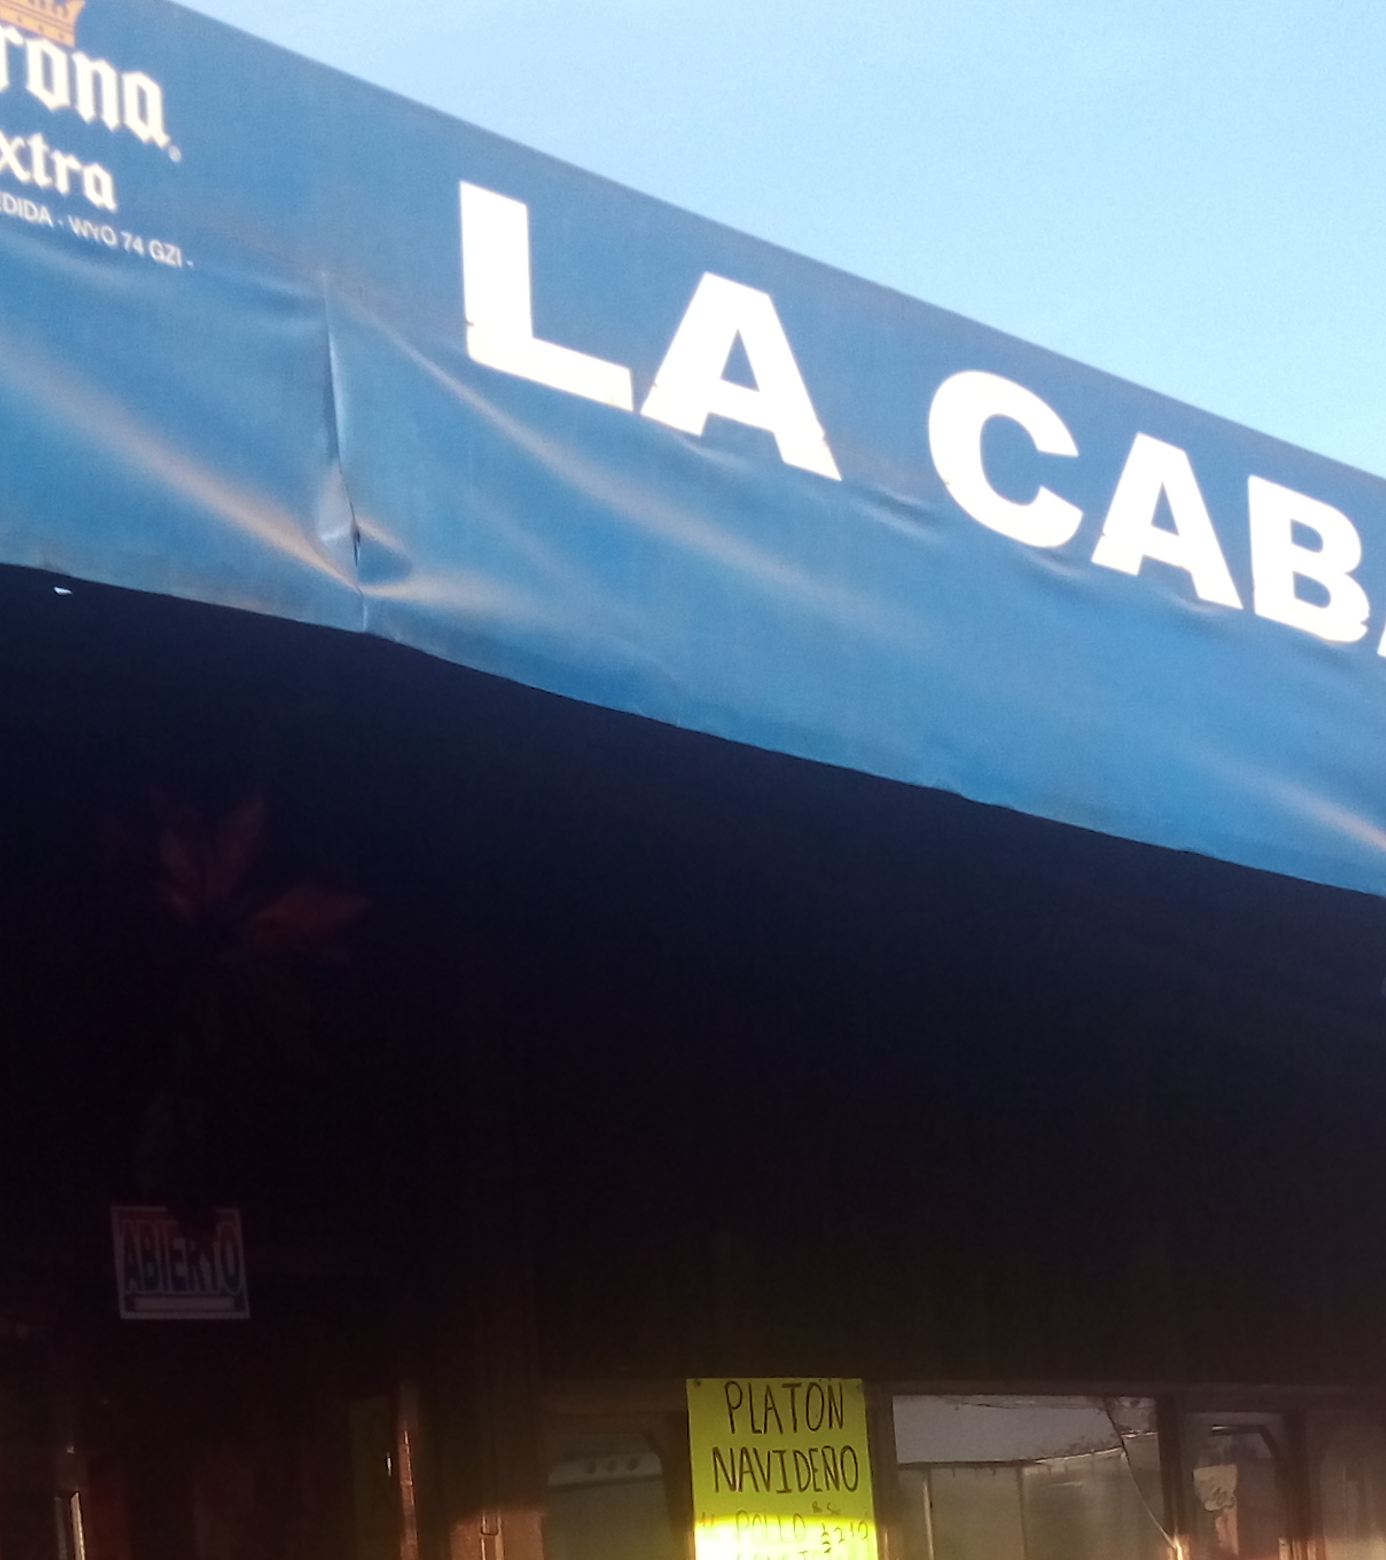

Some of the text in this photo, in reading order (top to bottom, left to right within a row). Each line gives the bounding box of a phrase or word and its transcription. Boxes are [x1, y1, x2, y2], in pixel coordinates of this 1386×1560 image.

[121, 231, 146, 256] 74
[459, 181, 842, 481] LA
[724, 1380, 844, 1435] PLATON
[735, 1509, 807, 1545] POLLO
